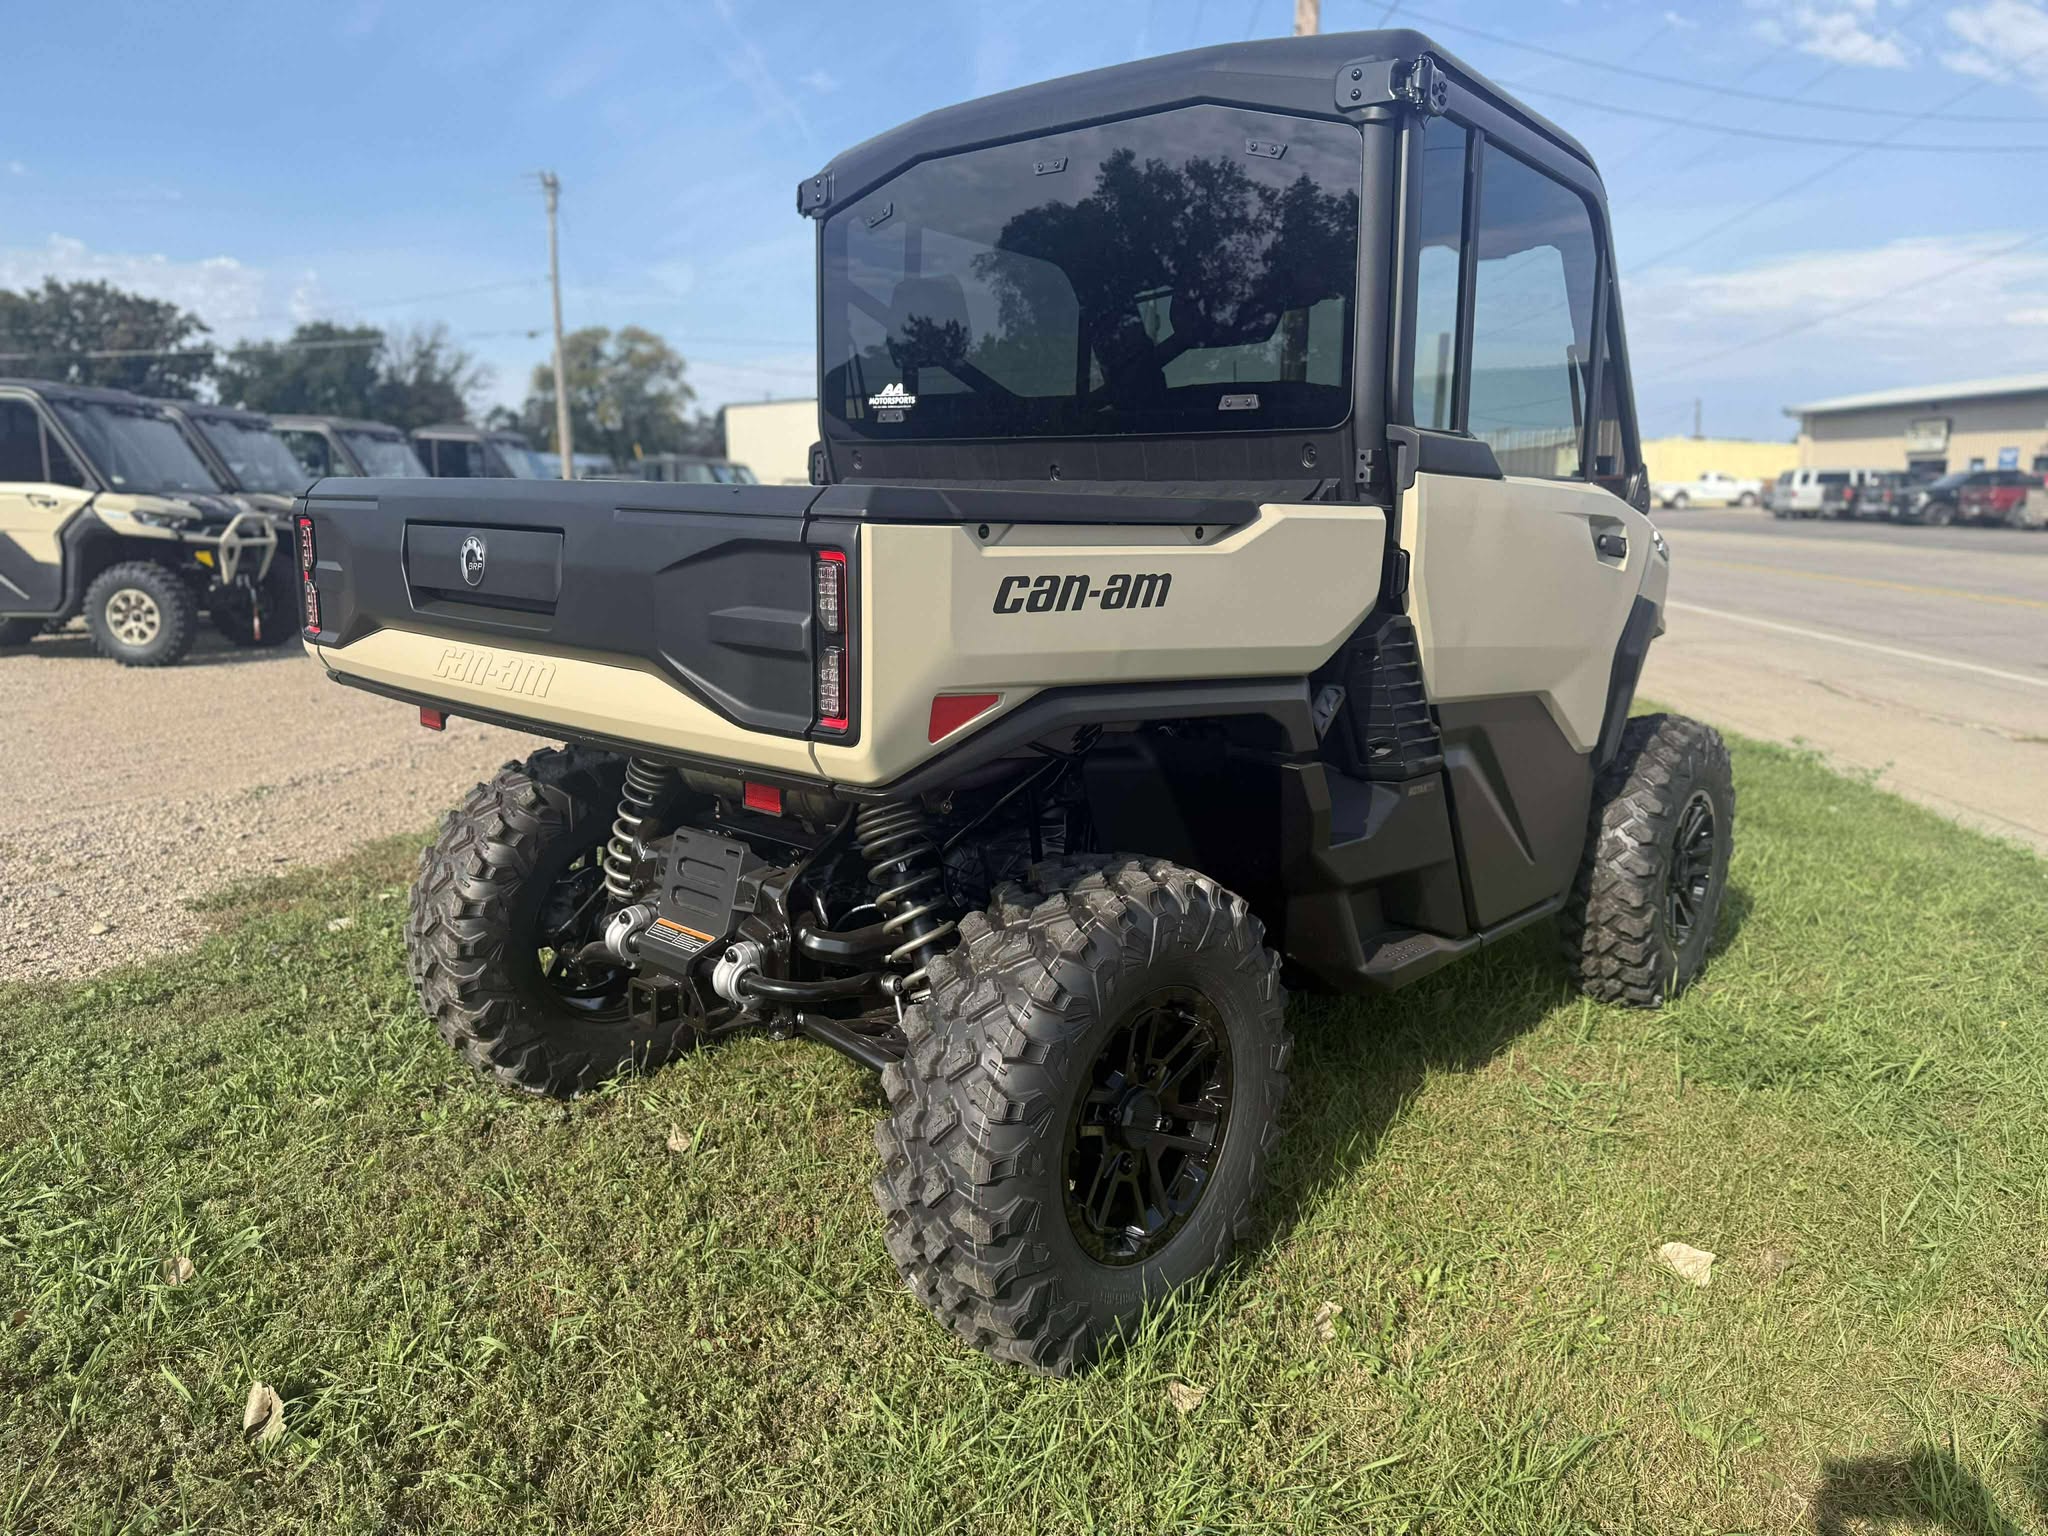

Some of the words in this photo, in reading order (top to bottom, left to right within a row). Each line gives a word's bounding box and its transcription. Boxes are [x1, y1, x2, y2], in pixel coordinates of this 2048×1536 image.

[868, 396, 916, 405] MOTORSPORTS
[468, 562, 483, 571] BRP
[992, 572, 1172, 614] can-am
